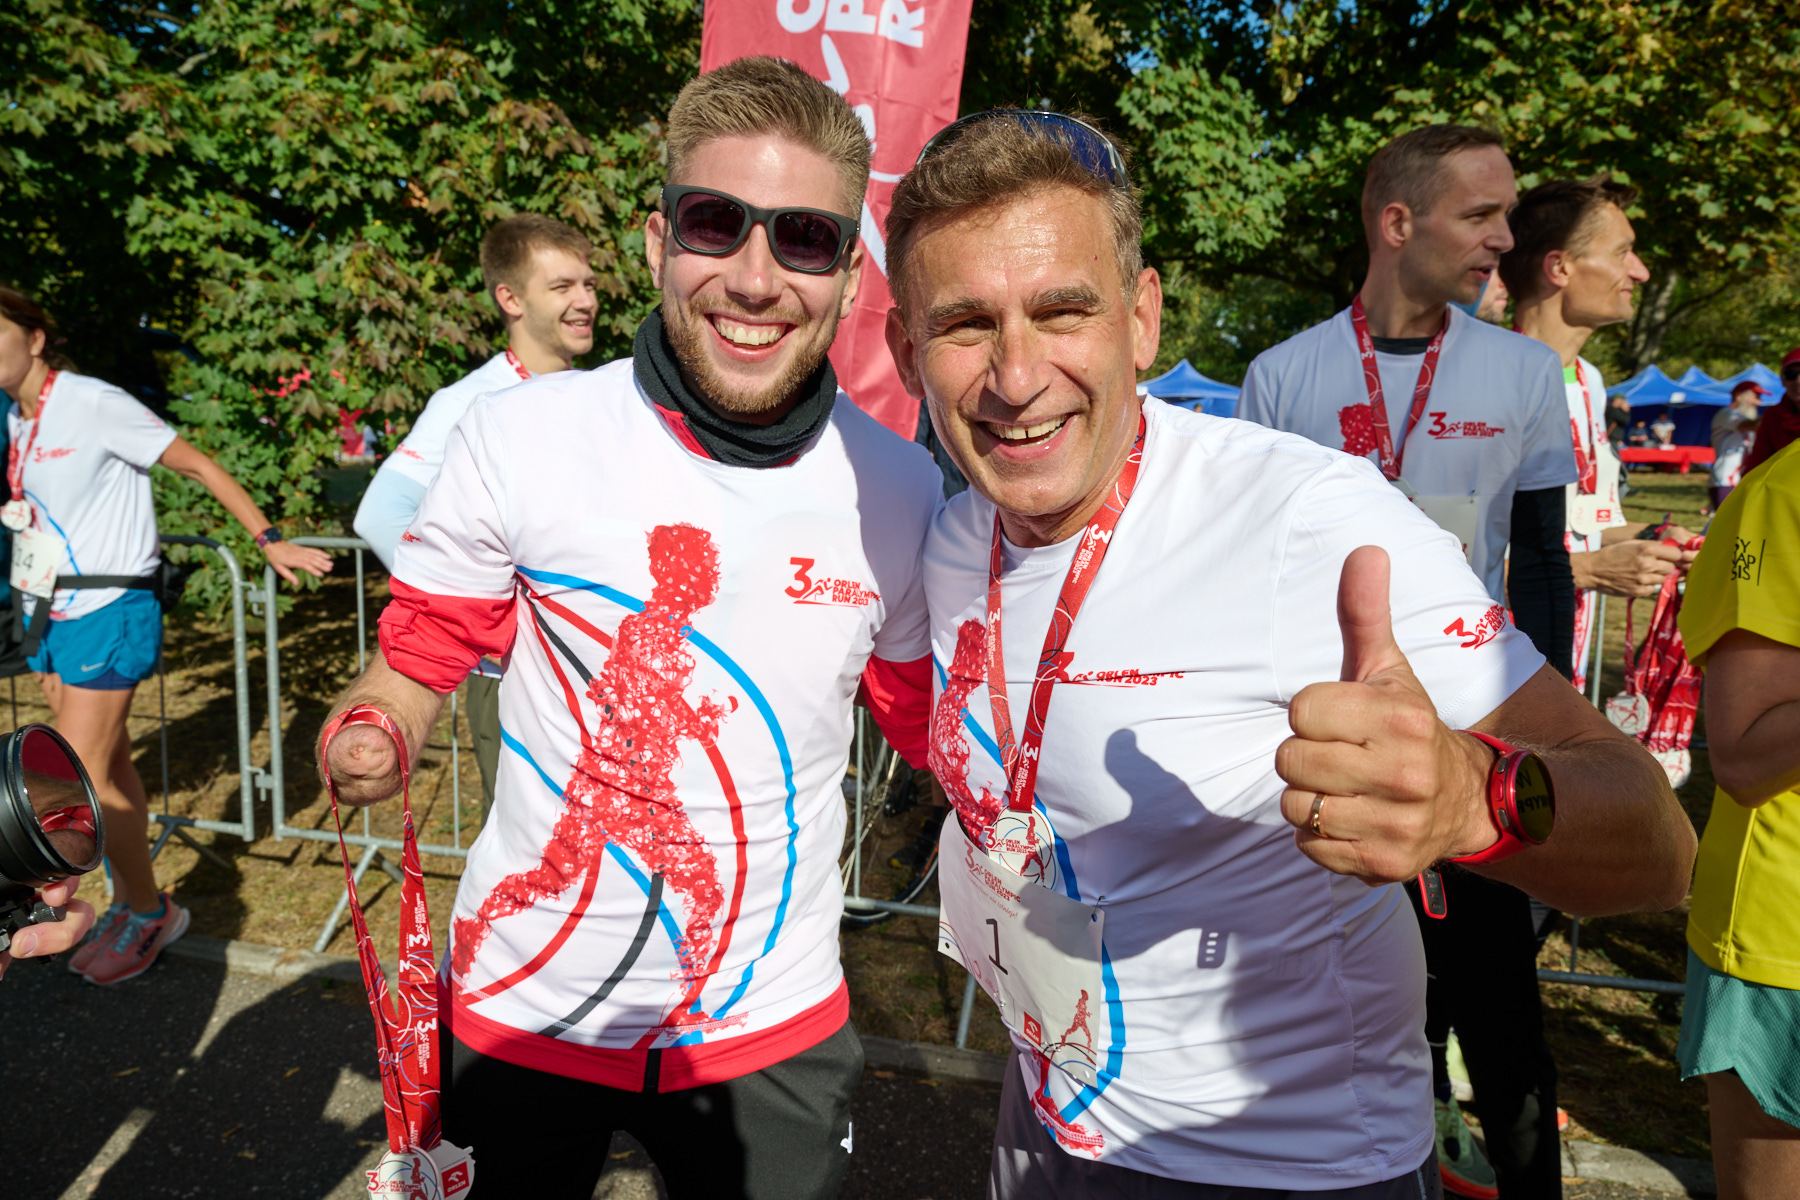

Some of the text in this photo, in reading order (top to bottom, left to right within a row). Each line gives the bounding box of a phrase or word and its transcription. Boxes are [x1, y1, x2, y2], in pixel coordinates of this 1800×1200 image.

[1427, 412, 1447, 436] 3
[1091, 524, 1113, 544] 3
[784, 557, 815, 599] 3
[834, 579, 861, 589] ORLEN
[832, 594, 851, 603] RUN
[1443, 617, 1480, 648] 3
[1125, 674, 1158, 686] 2023
[1024, 742, 1039, 761] 3
[984, 828, 996, 849] 3
[964, 839, 974, 869] 3
[409, 934, 429, 947] 3
[986, 918, 1008, 975] 1
[417, 1018, 437, 1033] 3
[366, 1172, 380, 1191] 3
[447, 1180, 466, 1192] ORLEN
